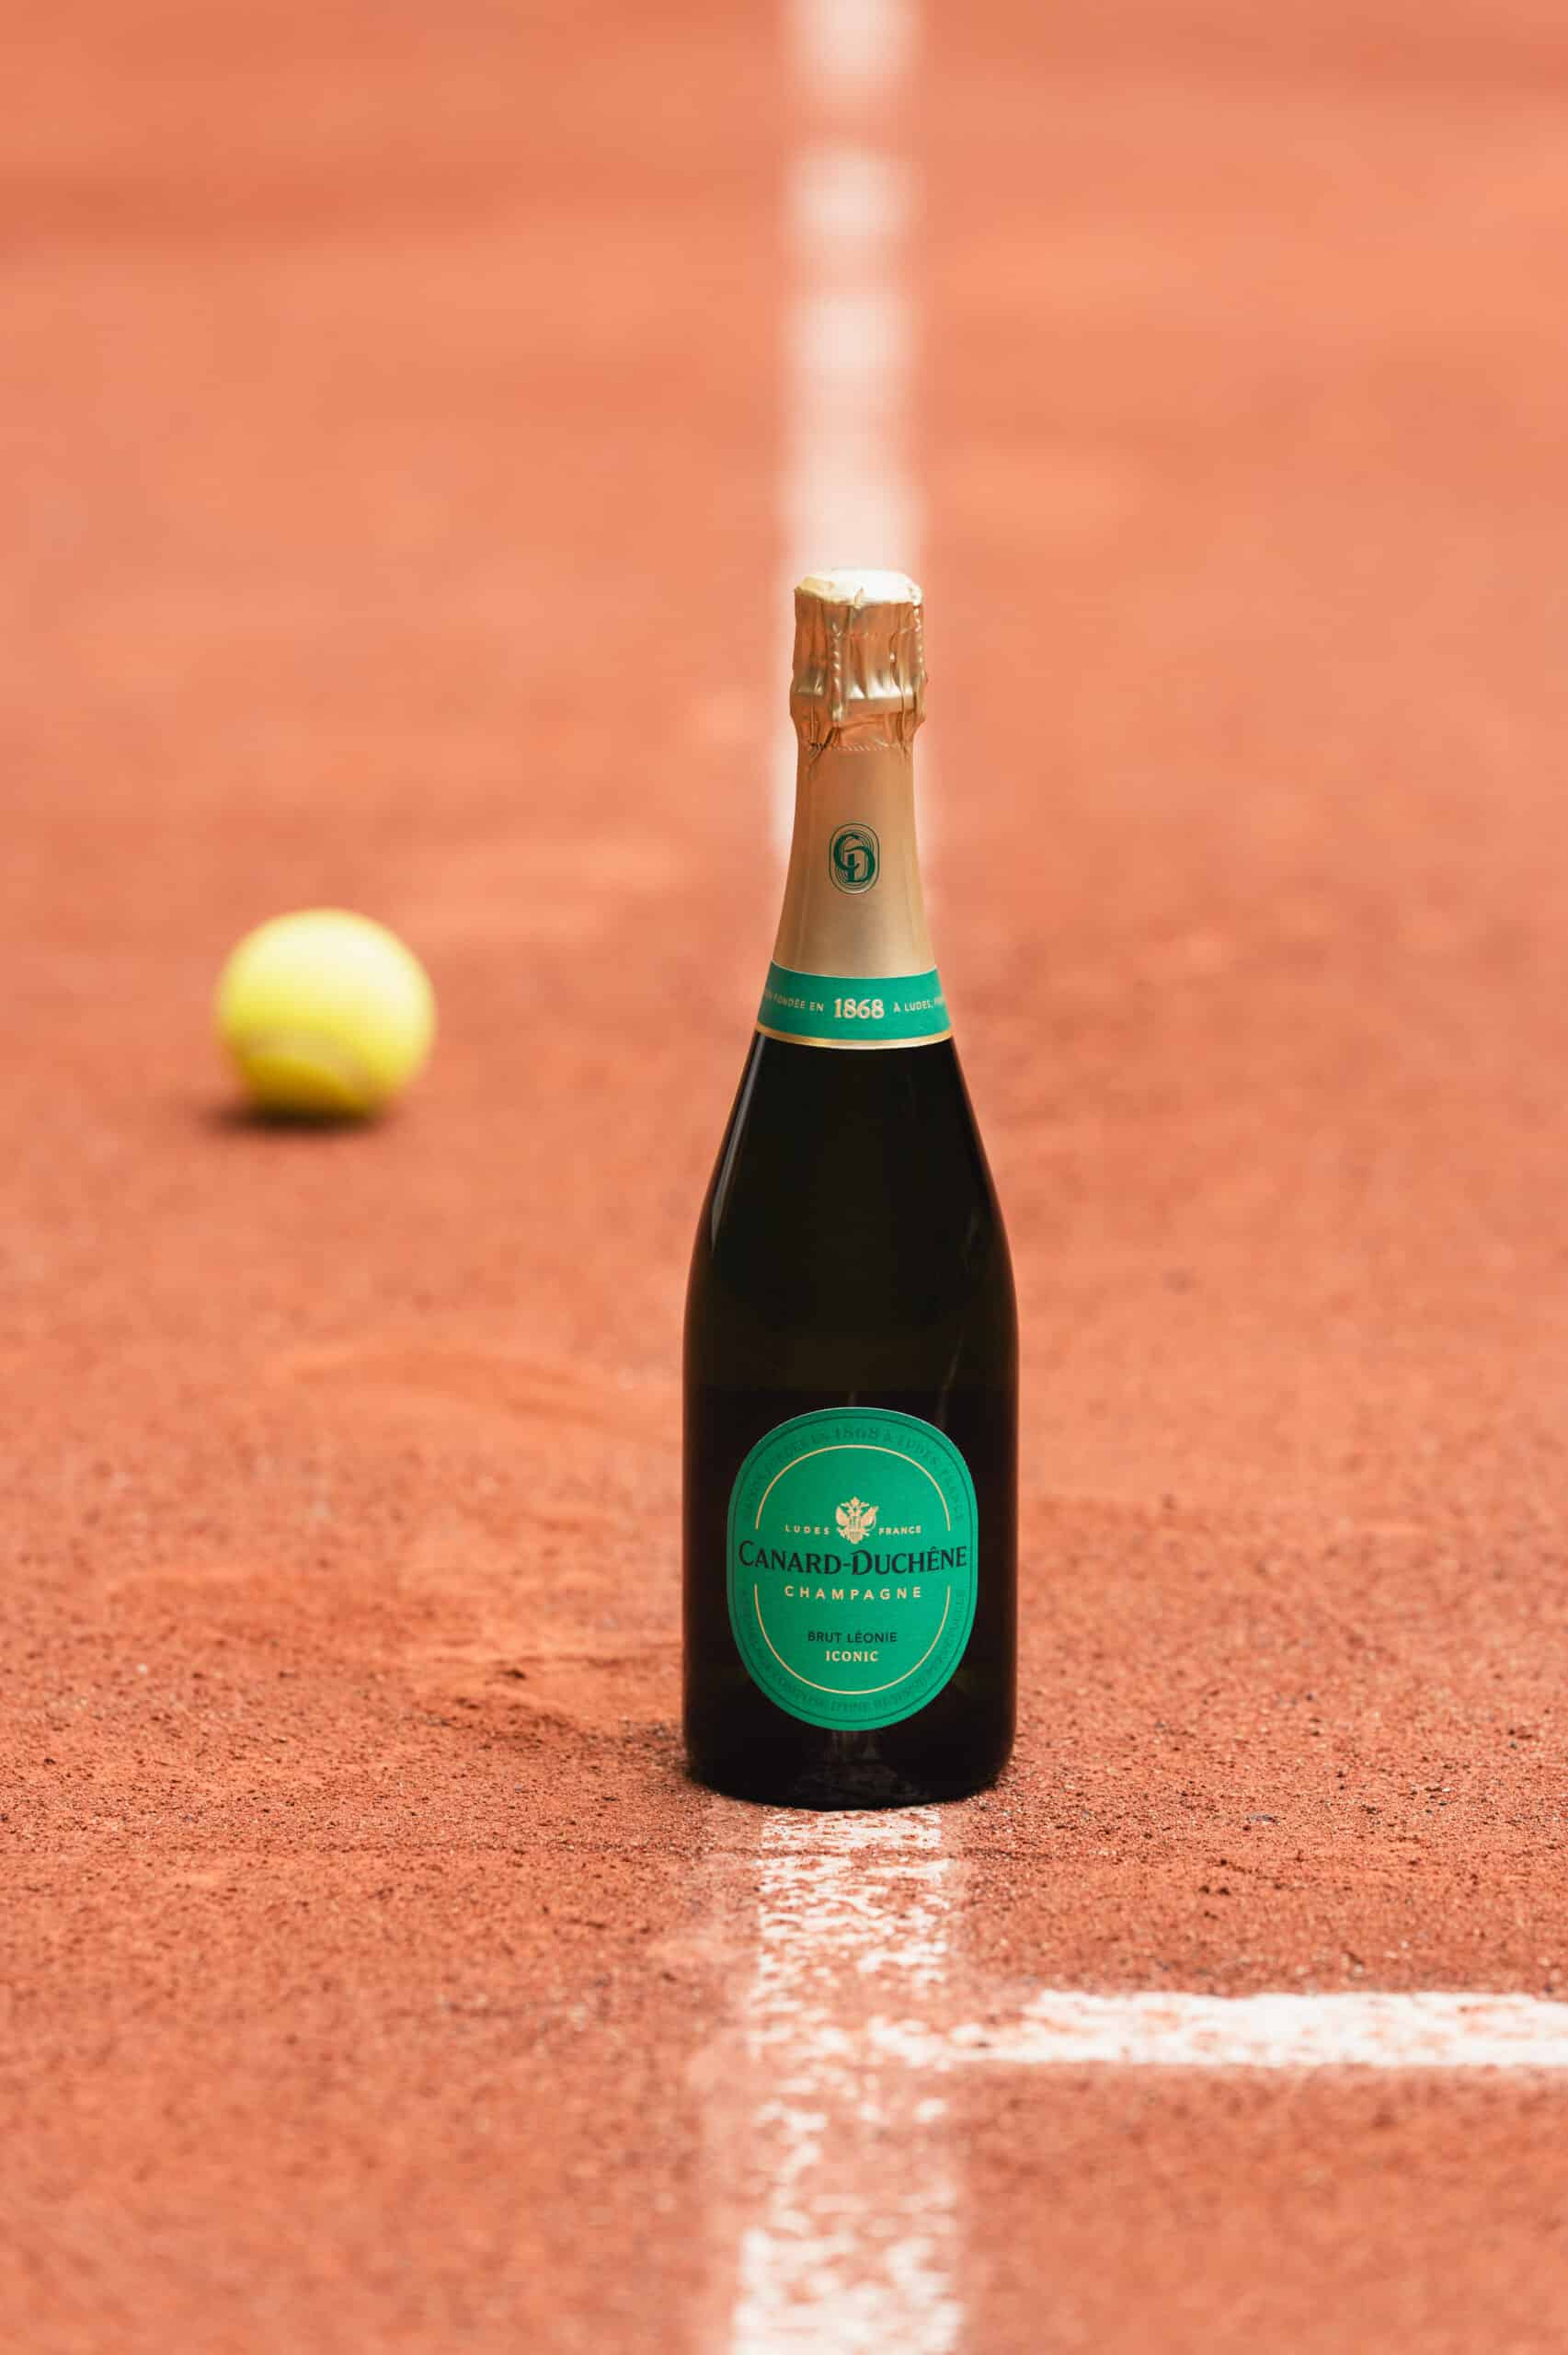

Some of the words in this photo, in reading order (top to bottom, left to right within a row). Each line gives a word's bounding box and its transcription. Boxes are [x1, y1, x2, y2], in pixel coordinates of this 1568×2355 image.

[809, 1001, 824, 1012] EN
[834, 998, 885, 1019] 1868
[784, 1524, 830, 1535] LUDES
[878, 1525, 921, 1535] FRANCE
[738, 1540, 967, 1575] CANARD-DUCHÊNE
[784, 1585, 921, 1600] CHAMPAGNE
[807, 1631, 841, 1643] BRUT
[846, 1628, 898, 1643] LÉONIE
[825, 1650, 879, 1662] ICONIC
